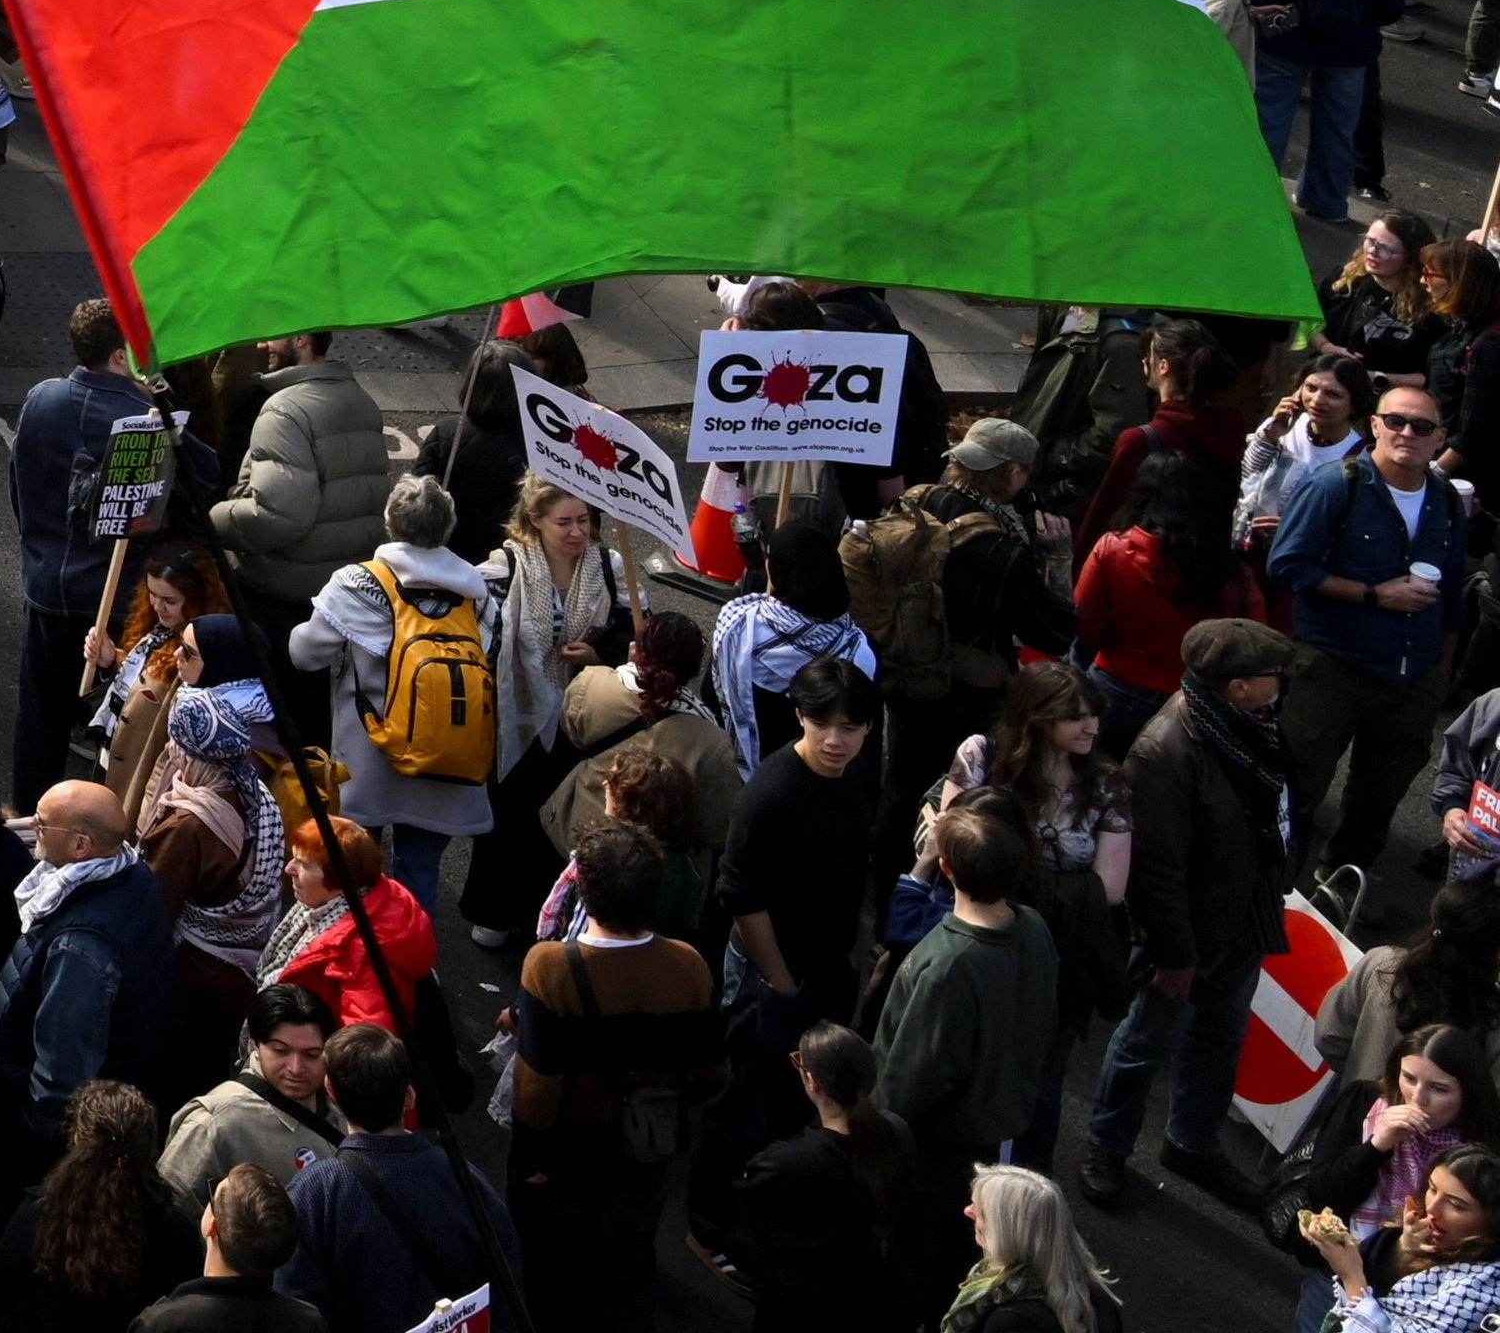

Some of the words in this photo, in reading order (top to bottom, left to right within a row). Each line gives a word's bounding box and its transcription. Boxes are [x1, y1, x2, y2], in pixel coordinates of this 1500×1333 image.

[706, 353, 885, 407] Gza
[703, 416, 746, 437] Stop
[751, 415, 783, 434] the
[786, 414, 882, 438] genocide
[113, 433, 149, 451] FROM
[526, 393, 675, 509] Gza
[110, 450, 147, 468] RIVER
[151, 448, 165, 465] TO
[107, 469, 132, 483] THE
[135, 467, 157, 483] SEA
[102, 481, 165, 501] PALESTINE
[535, 440, 572, 470] Stop
[574, 463, 602, 486] the
[606, 475, 684, 537] genocide
[99, 502, 129, 518] WILL
[132, 501, 146, 517] BE
[95, 519, 126, 537] FREE
